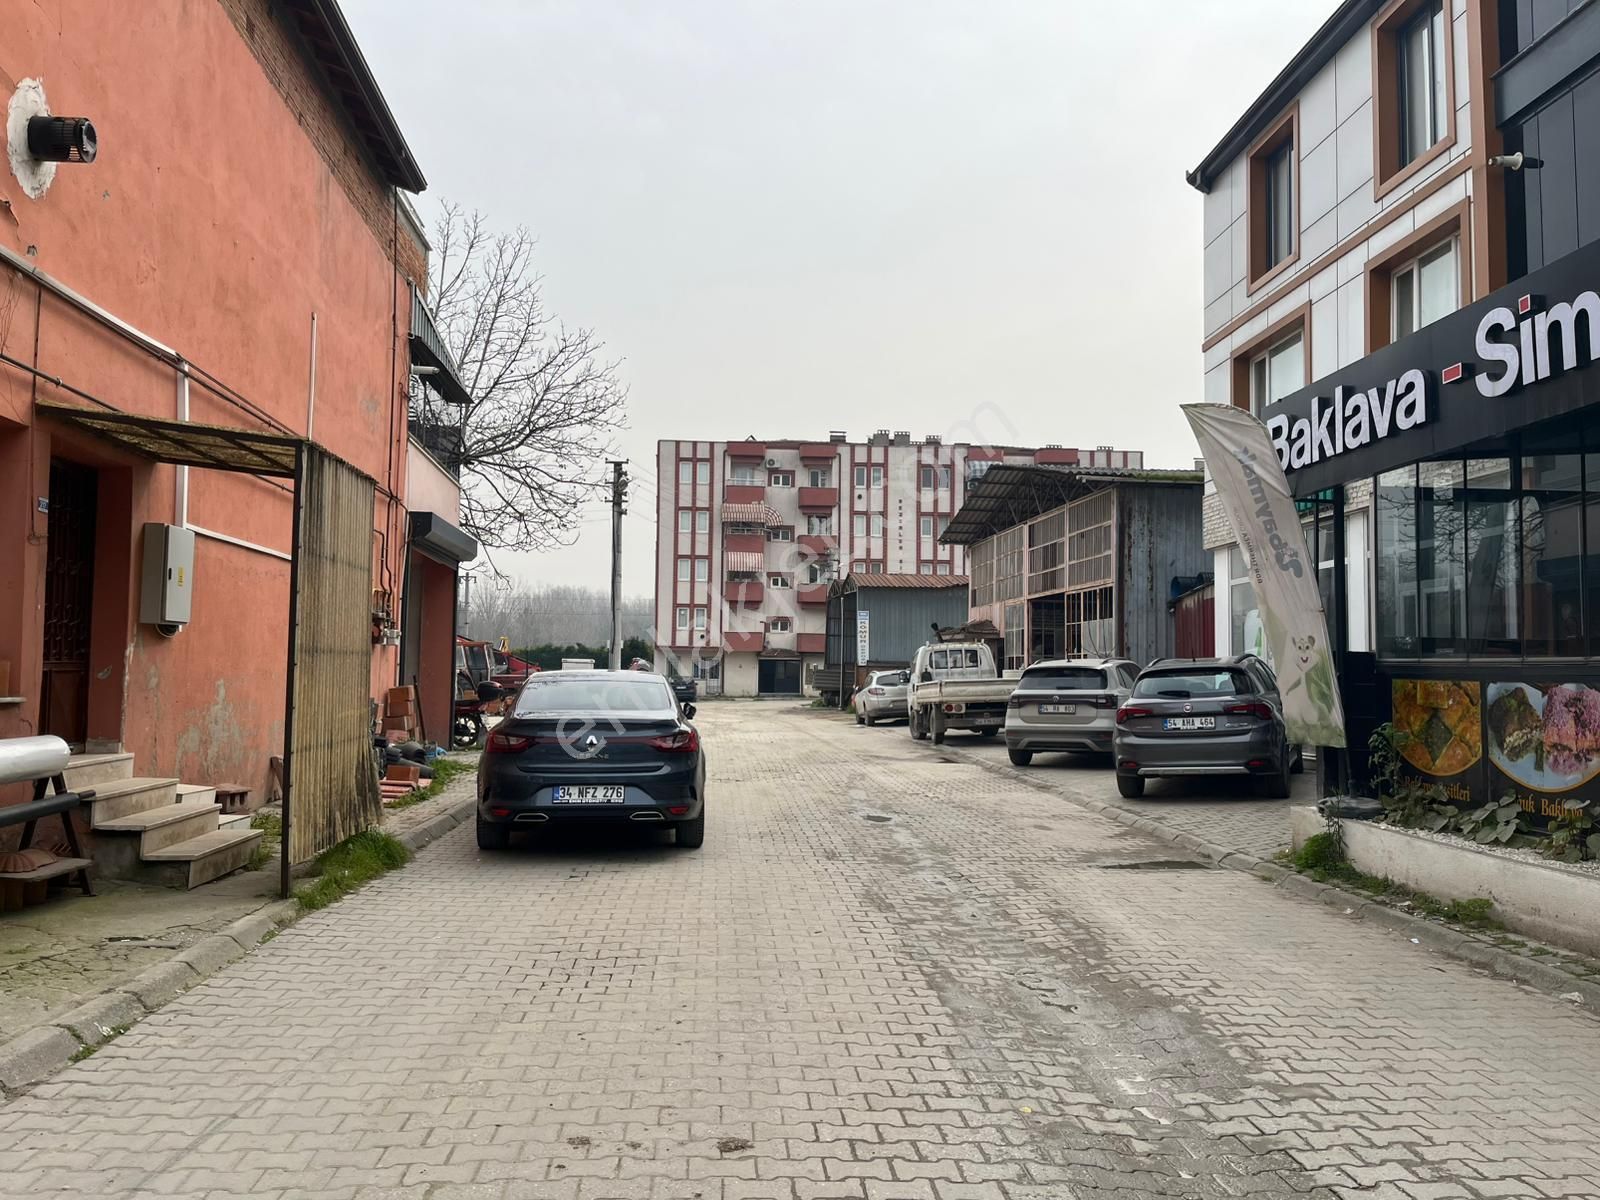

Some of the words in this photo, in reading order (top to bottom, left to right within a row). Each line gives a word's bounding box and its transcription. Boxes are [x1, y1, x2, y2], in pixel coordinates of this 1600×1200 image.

[1267, 368, 1426, 472] Baklava
[560, 787, 572, 798] 34
[578, 786, 598, 798] NFZ
[603, 786, 623, 798] 276
